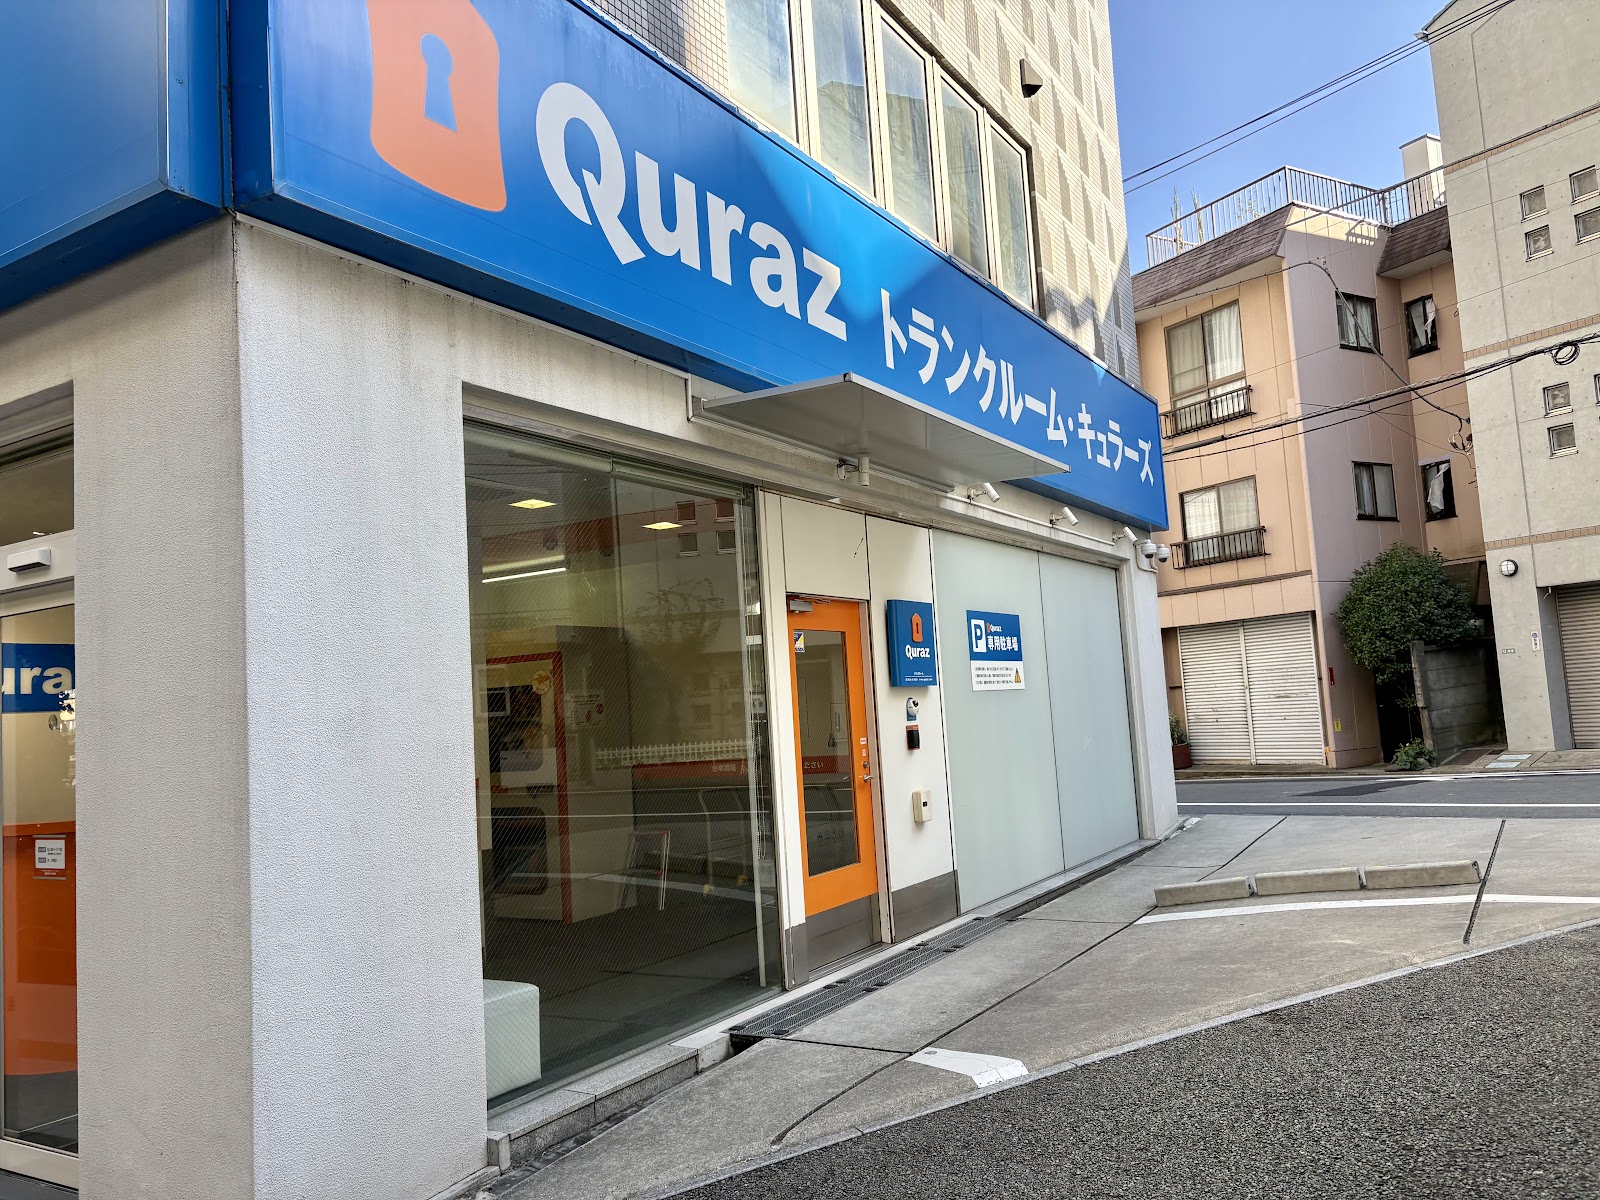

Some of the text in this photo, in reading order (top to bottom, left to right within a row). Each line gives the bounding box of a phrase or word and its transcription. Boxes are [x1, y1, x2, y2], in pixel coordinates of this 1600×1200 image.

[536, 82, 847, 342] Quraz
[880, 287, 1154, 486] トランクルーム・キュラーズ
[990, 624, 1002, 632] Quraz
[987, 635, 1018, 651] 専用駐車場
[905, 644, 930, 660] Quraz
